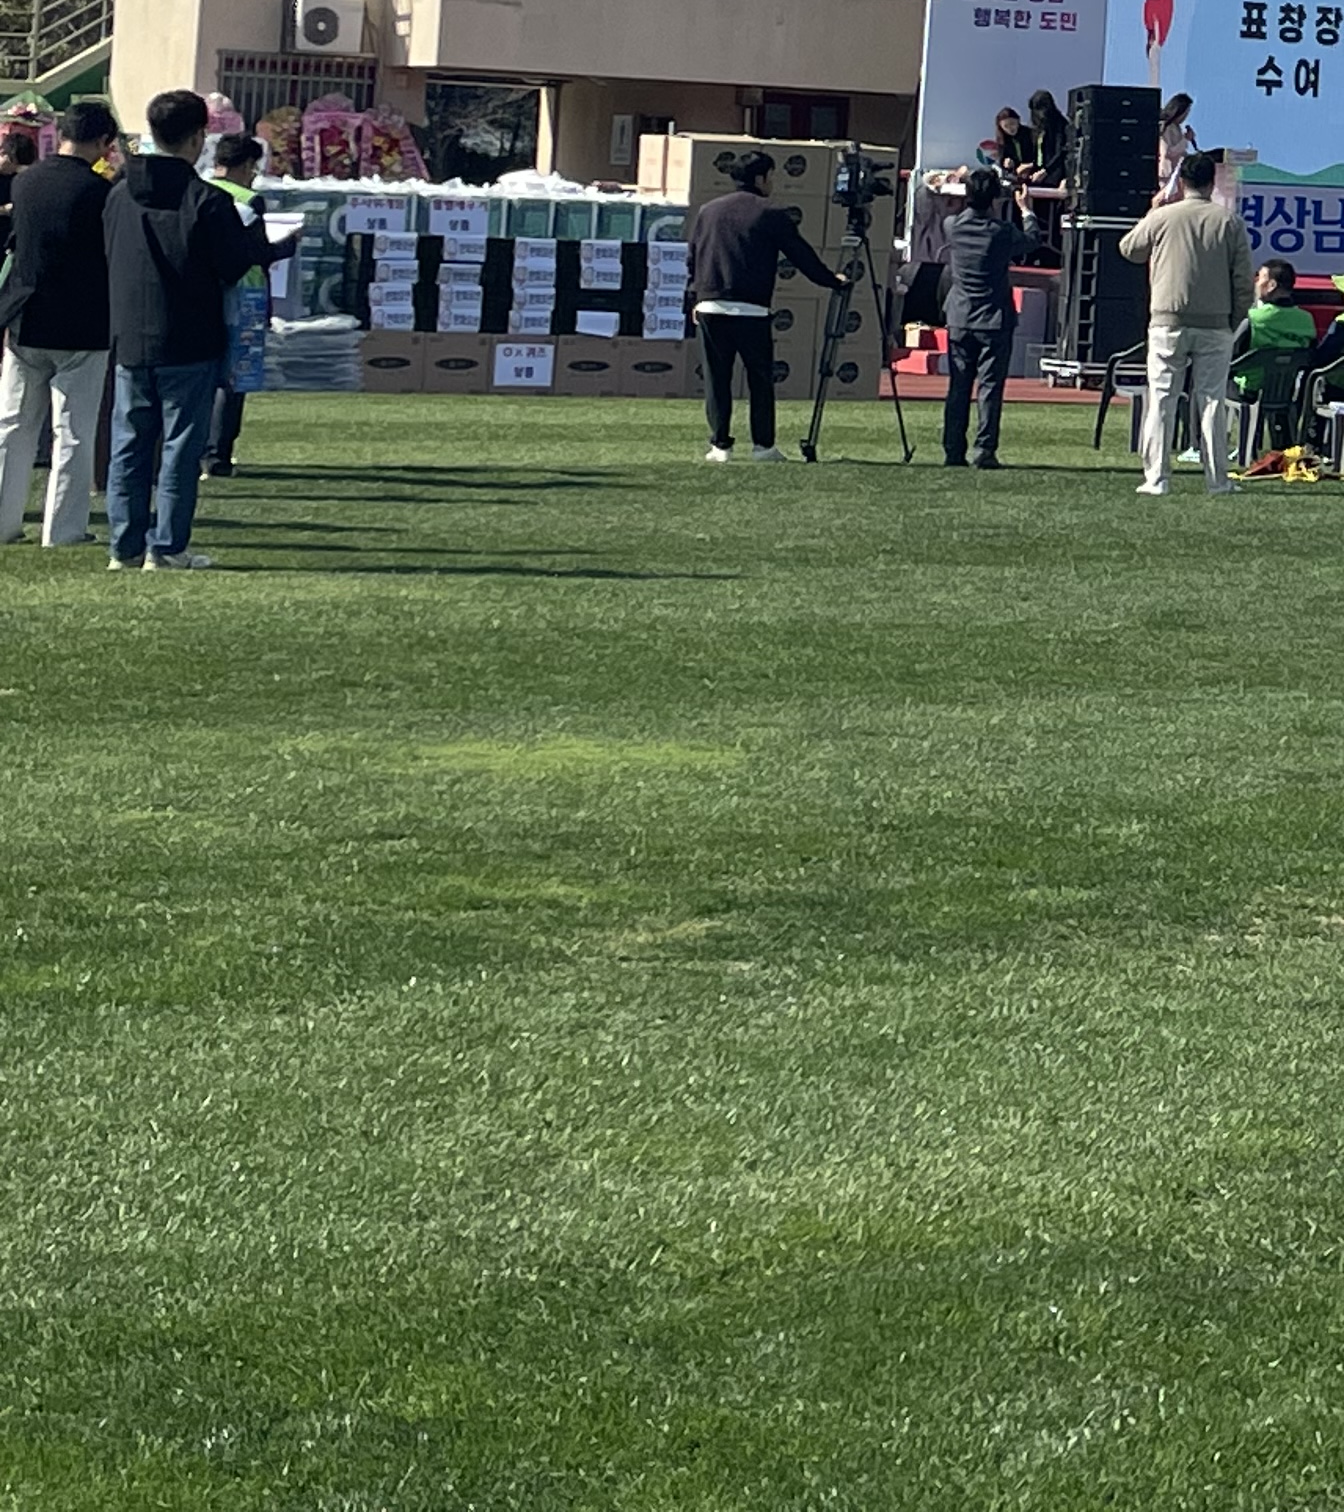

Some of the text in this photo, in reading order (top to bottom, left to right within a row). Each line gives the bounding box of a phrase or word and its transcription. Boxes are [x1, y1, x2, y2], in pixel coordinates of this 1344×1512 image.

[974, 7, 1077, 31] 행복한 도민
[1240, 1, 1344, 45] 표창장
[1256, 55, 1320, 98] 수여
